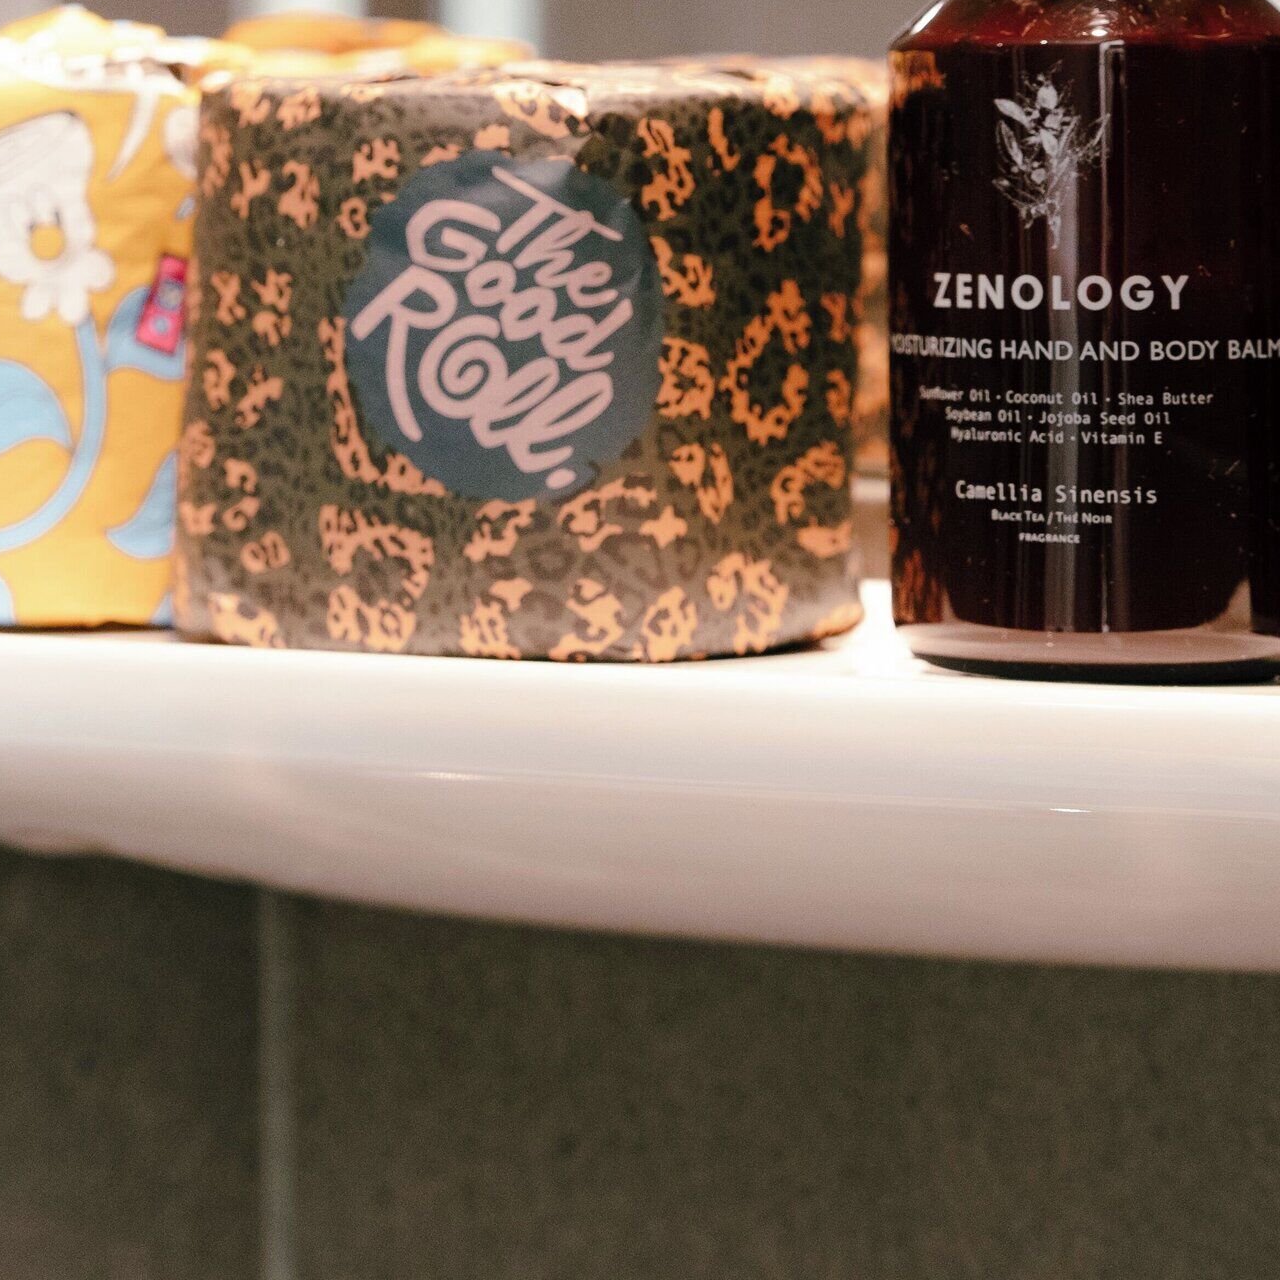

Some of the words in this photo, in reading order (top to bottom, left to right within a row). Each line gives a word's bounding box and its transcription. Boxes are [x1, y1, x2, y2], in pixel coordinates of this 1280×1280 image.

[491, 166, 623, 308] The
[406, 199, 634, 371] Good
[933, 272, 1191, 311] ZENOLOGY
[1000, 339, 1073, 361] HAND
[1079, 340, 1140, 361] AND
[1150, 340, 1219, 361] BODY
[969, 388, 991, 403] Oil
[1005, 390, 1063, 405] Coconut
[1071, 392, 1098, 406] Oil
[1118, 392, 1154, 406] Shea
[1162, 392, 1214, 406] Butter
[945, 406, 992, 423] Soybean
[997, 409, 1021, 423] Oil
[1039, 411, 1091, 426] Jojoba
[1100, 411, 1136, 425] Seed
[1144, 412, 1171, 425] Oil
[950, 426, 1022, 443] Hyaluronic
[1029, 430, 1064, 444] Acid
[1081, 431, 1145, 445] Vitamin
[1154, 431, 1163, 444] E
[955, 480, 1042, 502] Camellia
[1055, 484, 1158, 505] Sinensis
[1019, 532, 1081, 544] FRAGRANCE
